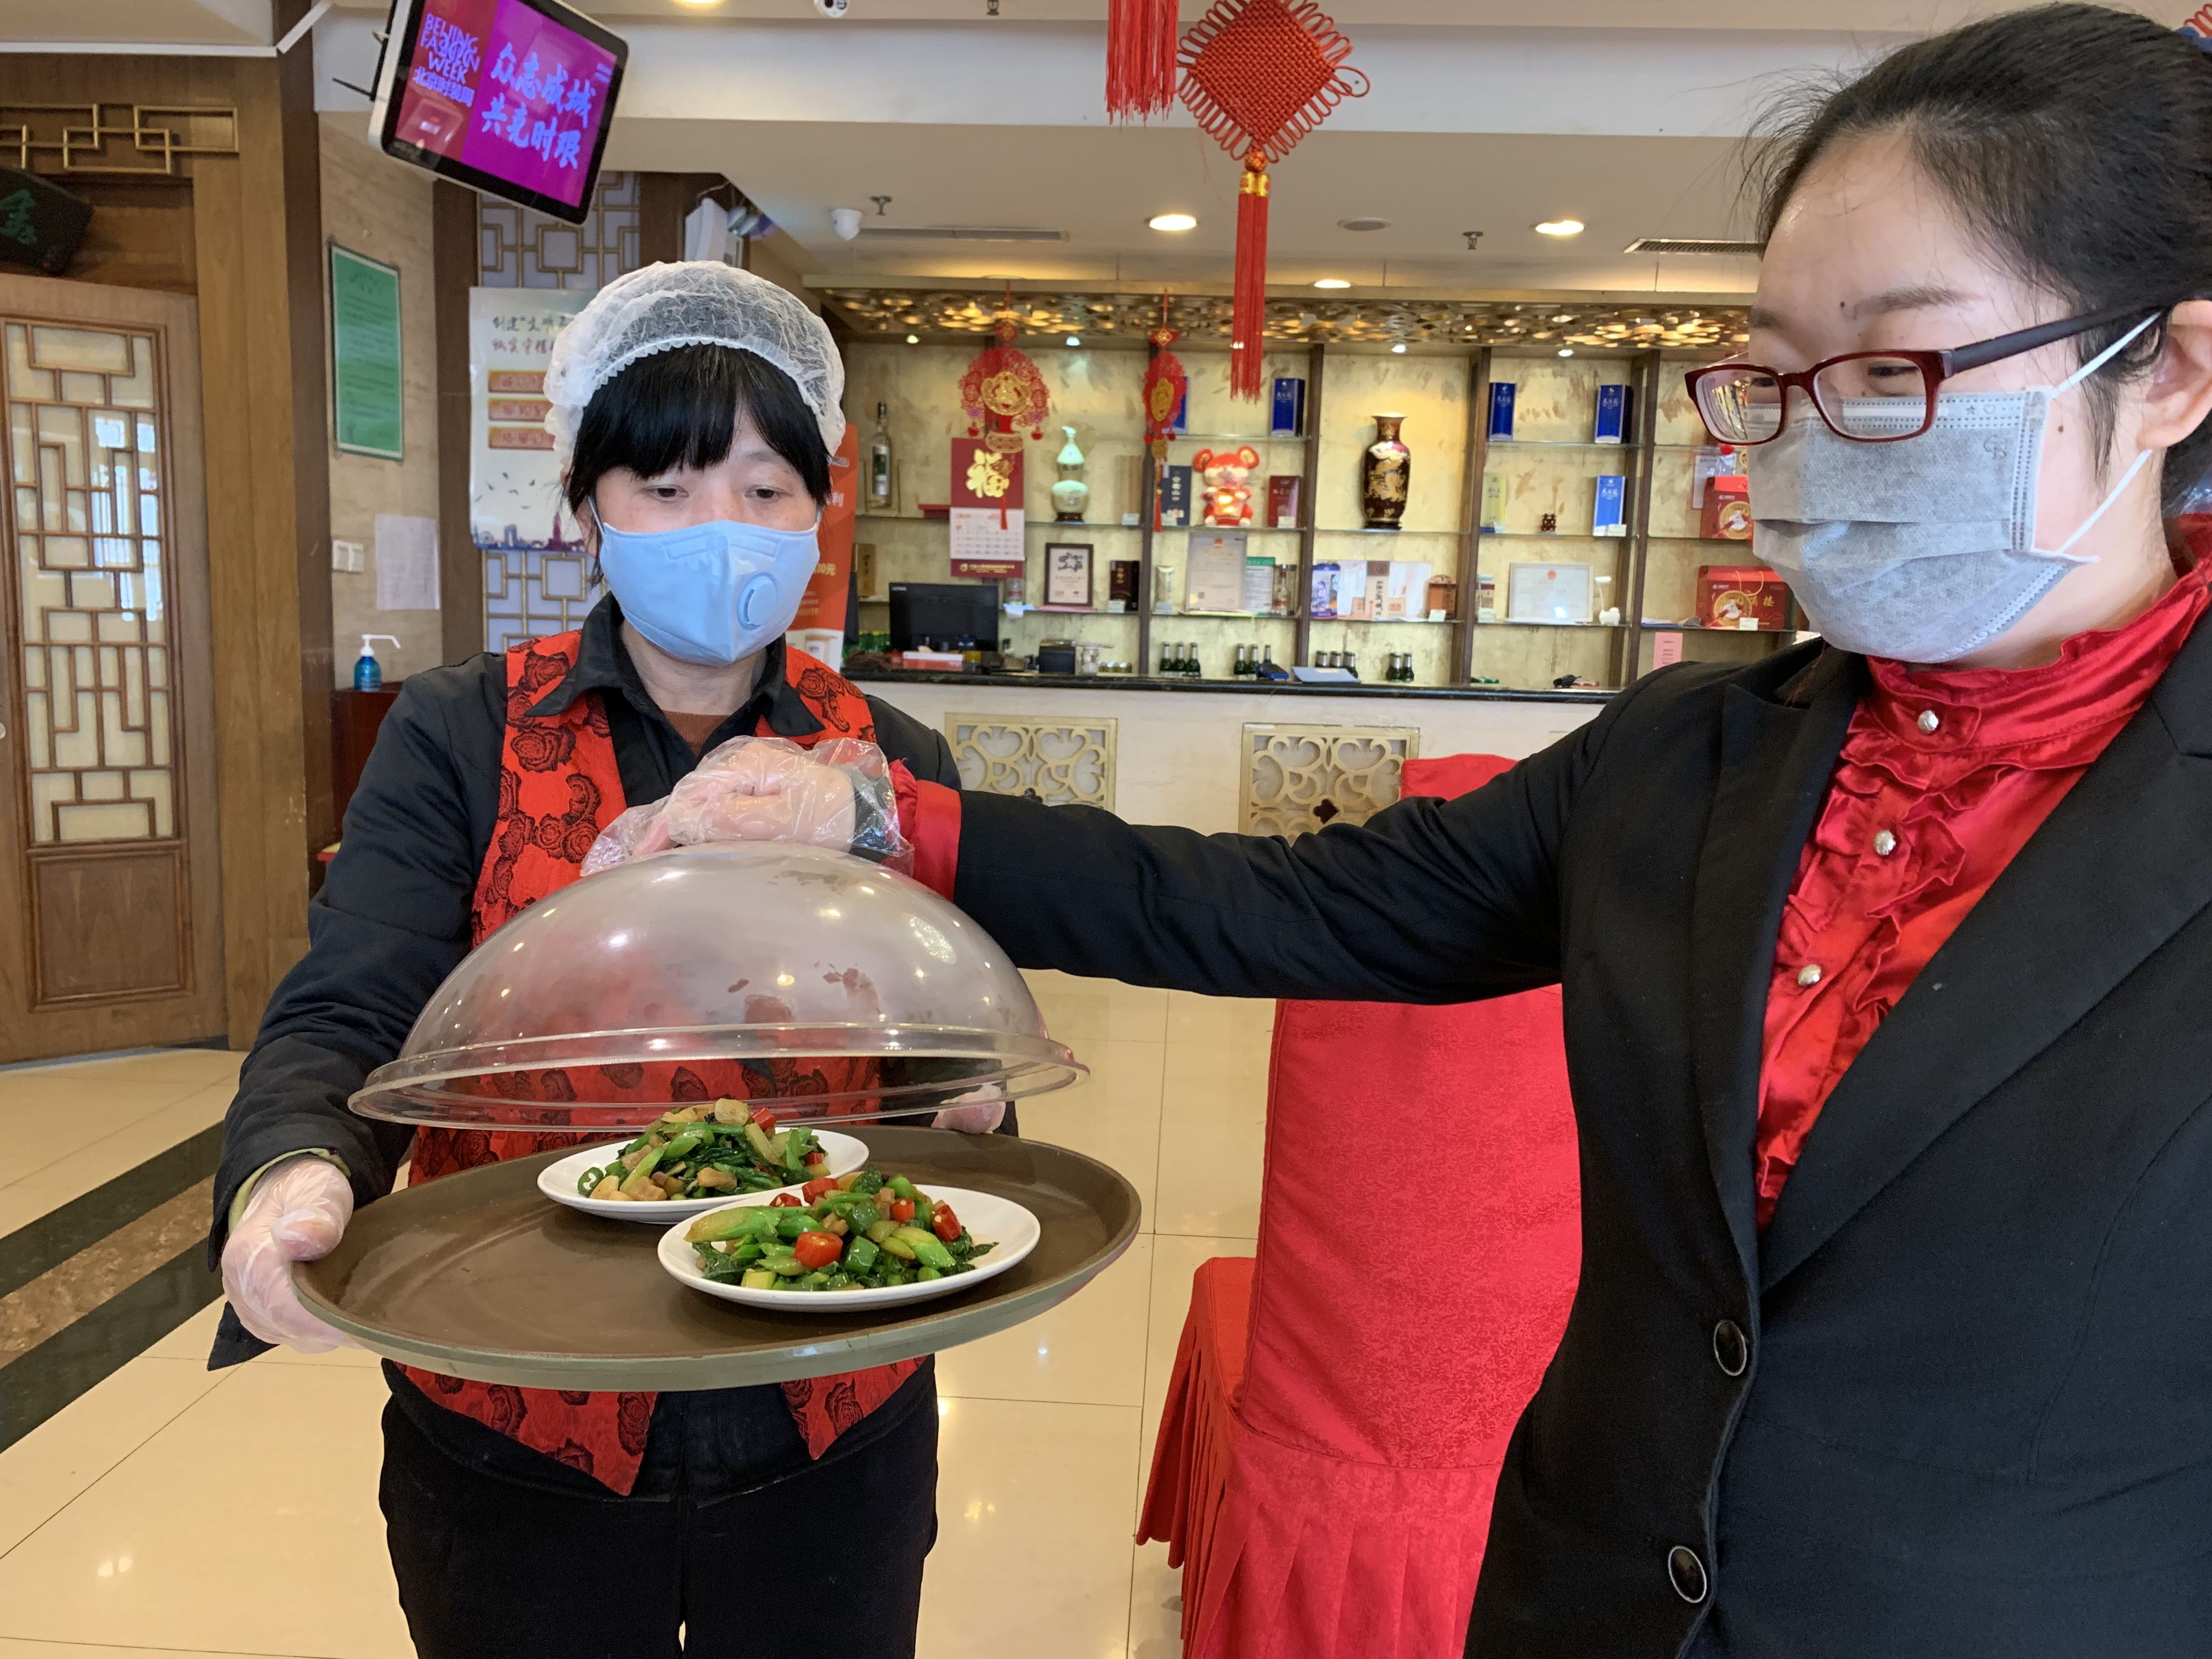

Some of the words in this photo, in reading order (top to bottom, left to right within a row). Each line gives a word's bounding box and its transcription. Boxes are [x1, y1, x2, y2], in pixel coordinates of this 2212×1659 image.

[425, 13, 479, 53] BEIJING
[413, 66, 475, 108] 北京时装周
[428, 51, 469, 84] WEEK
[490, 42, 596, 128] 众志成城
[482, 92, 581, 170] 共克时艰
[966, 449, 1010, 498] 福
